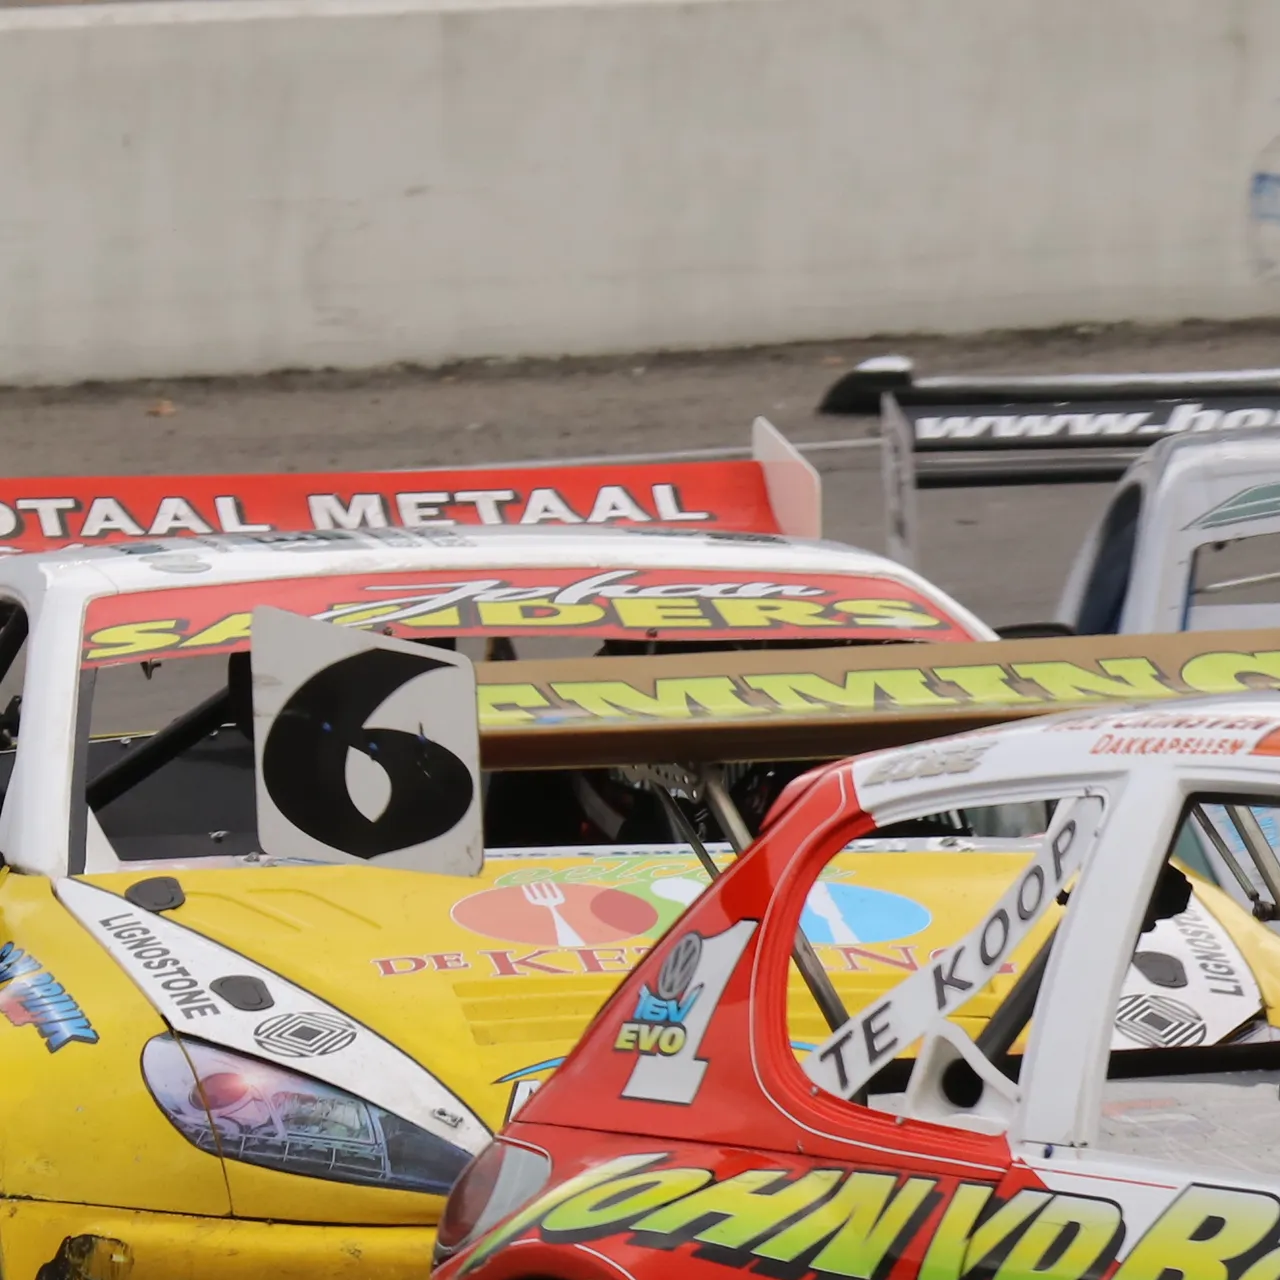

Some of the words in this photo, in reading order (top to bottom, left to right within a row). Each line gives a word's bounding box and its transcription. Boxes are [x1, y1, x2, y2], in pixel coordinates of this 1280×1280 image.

[307, 484, 709, 531] METAAL
[312, 570, 825, 627] Johan
[262, 646, 475, 859] 6
[99, 912, 221, 1020] LIGNOSTONE
[371, 951, 470, 977] DE
[819, 1000, 898, 1090] TE
[933, 818, 1078, 1010] KOOP
[613, 1021, 687, 1057] EVO
